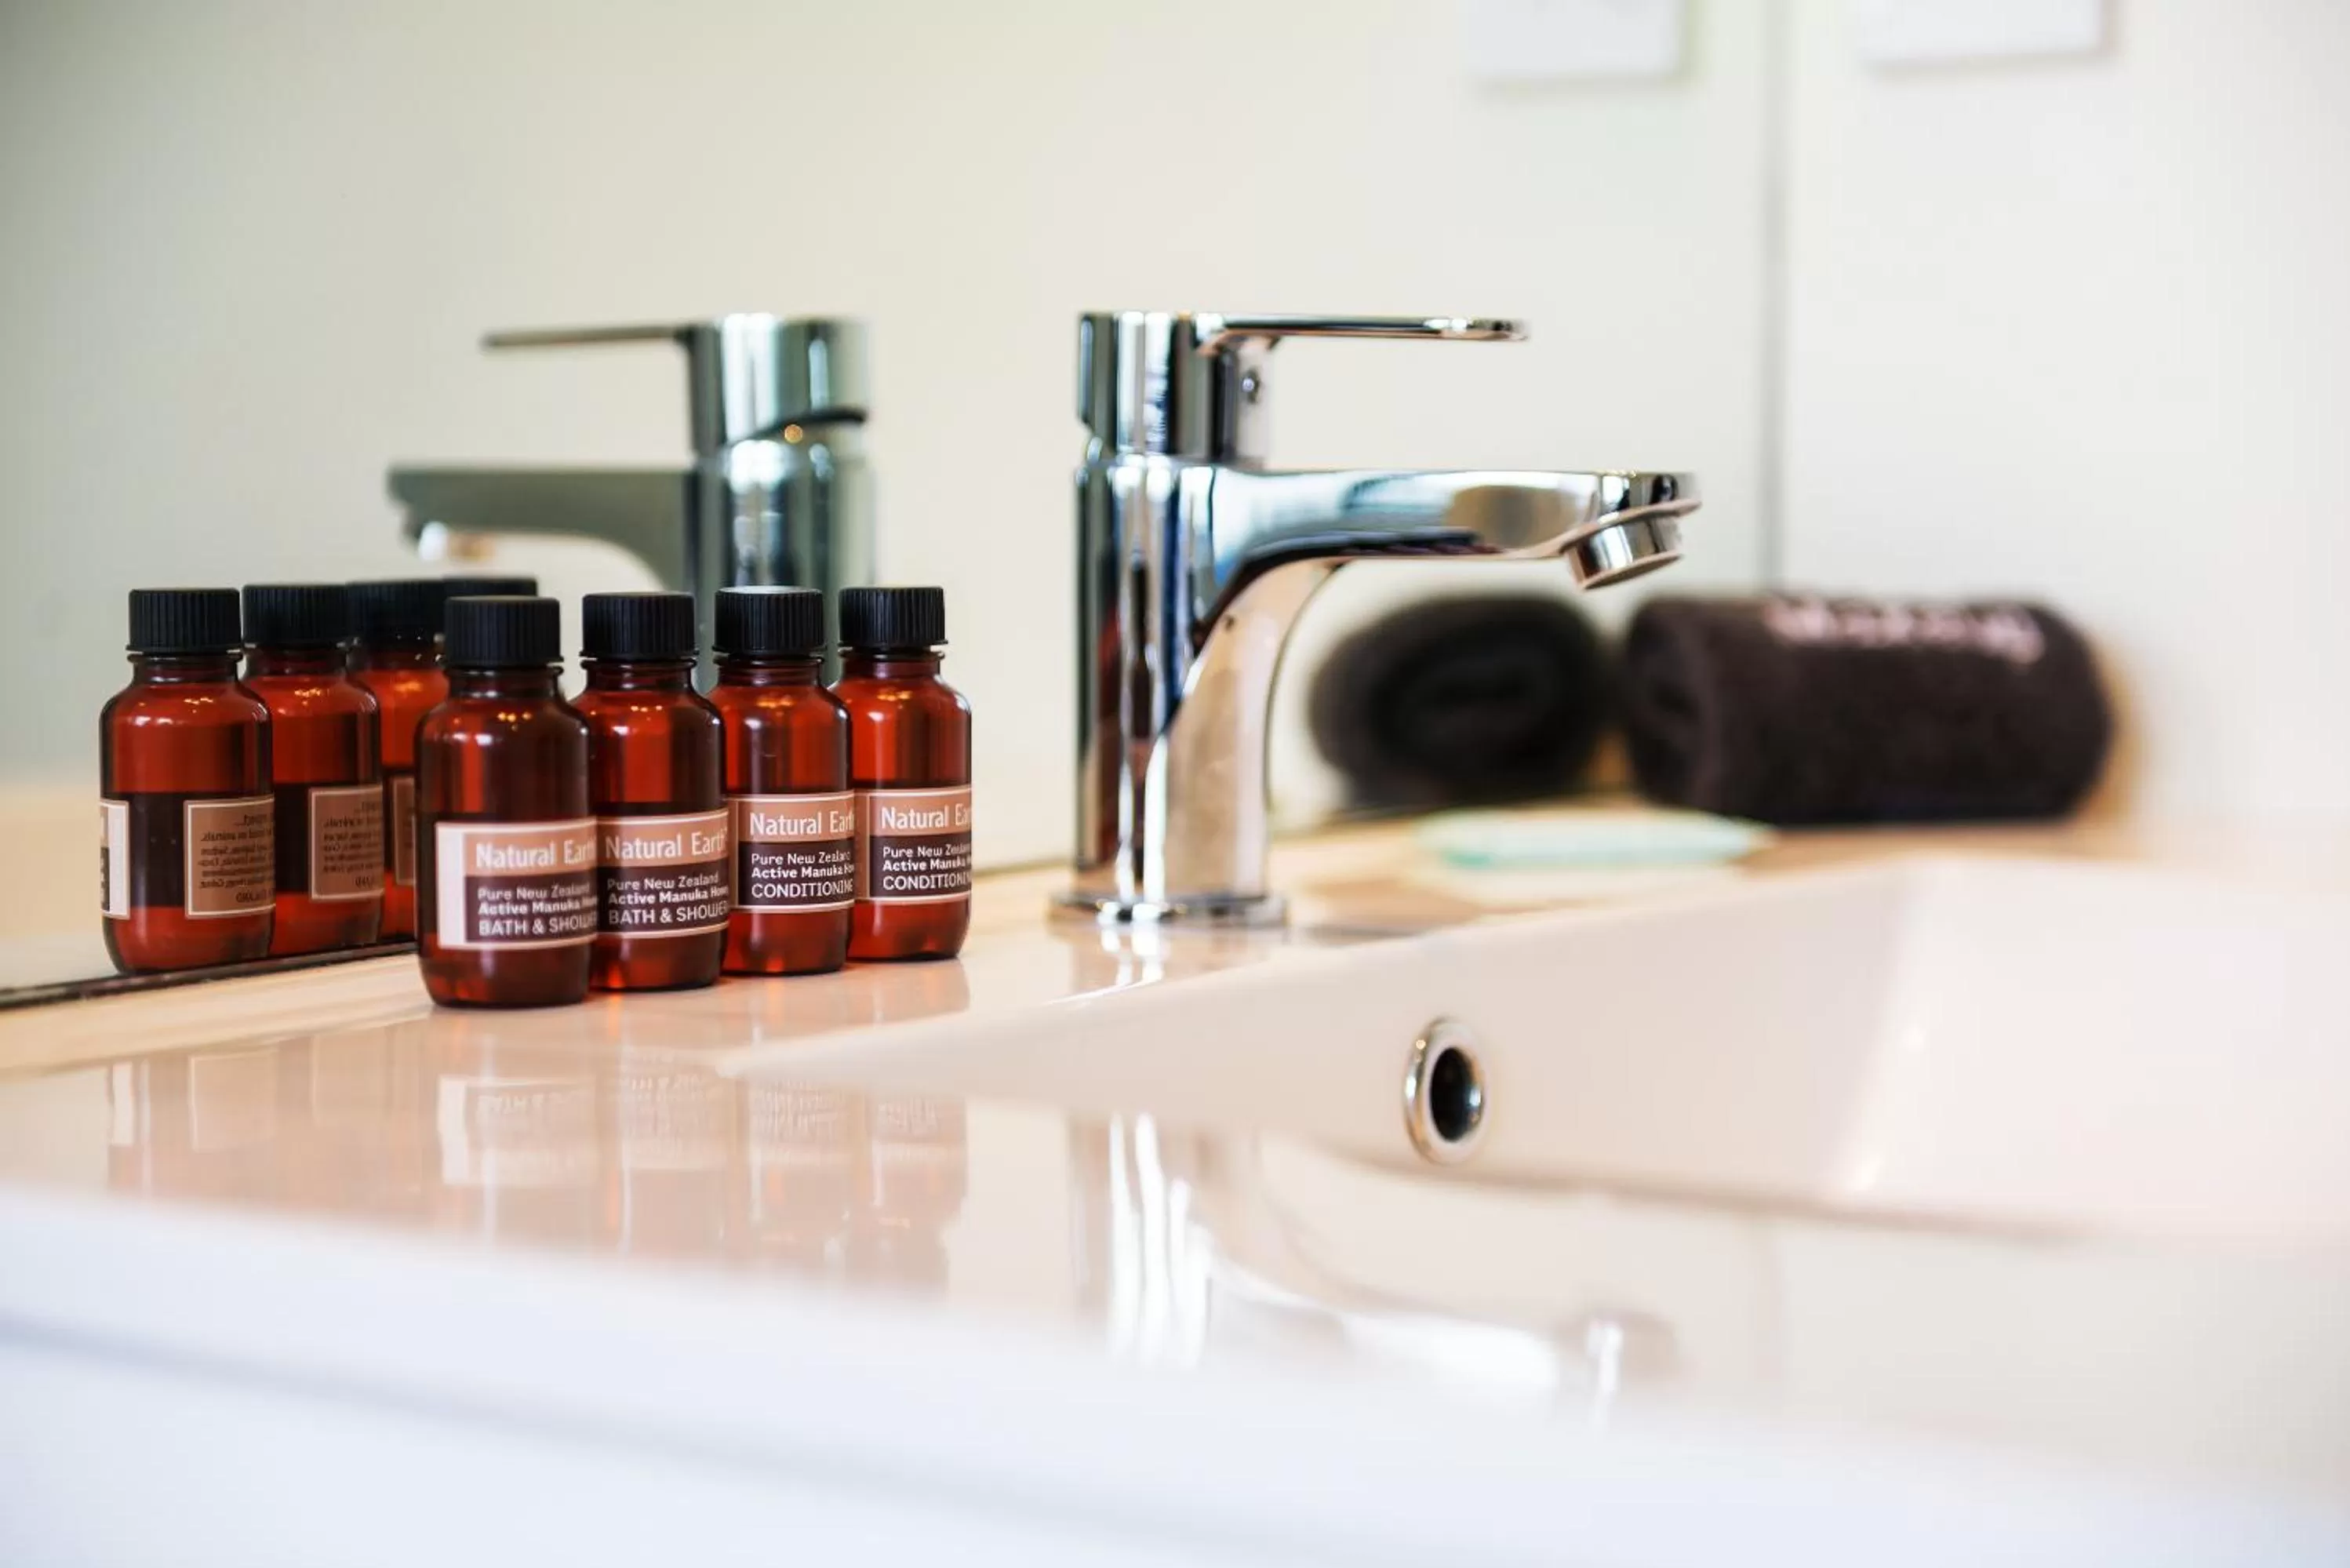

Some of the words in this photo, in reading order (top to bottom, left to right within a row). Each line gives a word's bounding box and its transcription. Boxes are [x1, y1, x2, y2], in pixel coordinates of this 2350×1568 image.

[750, 811, 821, 835] Natural
[882, 804, 949, 829] Natural
[476, 842, 555, 868] Natural
[606, 834, 682, 860] Natural
[882, 846, 913, 857] Pure
[917, 846, 942, 857] New
[751, 853, 784, 865] Pure
[787, 853, 815, 865] New
[882, 860, 926, 871] Active
[930, 857, 966, 870] Manuka
[751, 867, 798, 879] Active
[801, 864, 843, 878] Manuka
[607, 879, 640, 890] Pure
[643, 878, 675, 890] New
[678, 871, 719, 888] Zealand
[478, 887, 512, 900] Pure
[516, 886, 547, 900] New
[608, 893, 656, 904] Active
[659, 889, 708, 903] Manuka
[478, 902, 528, 915] Active
[532, 900, 580, 914] Manuka
[609, 908, 655, 925] BATH
[660, 908, 672, 923] &
[478, 919, 527, 936] BATH
[532, 918, 545, 935] &
